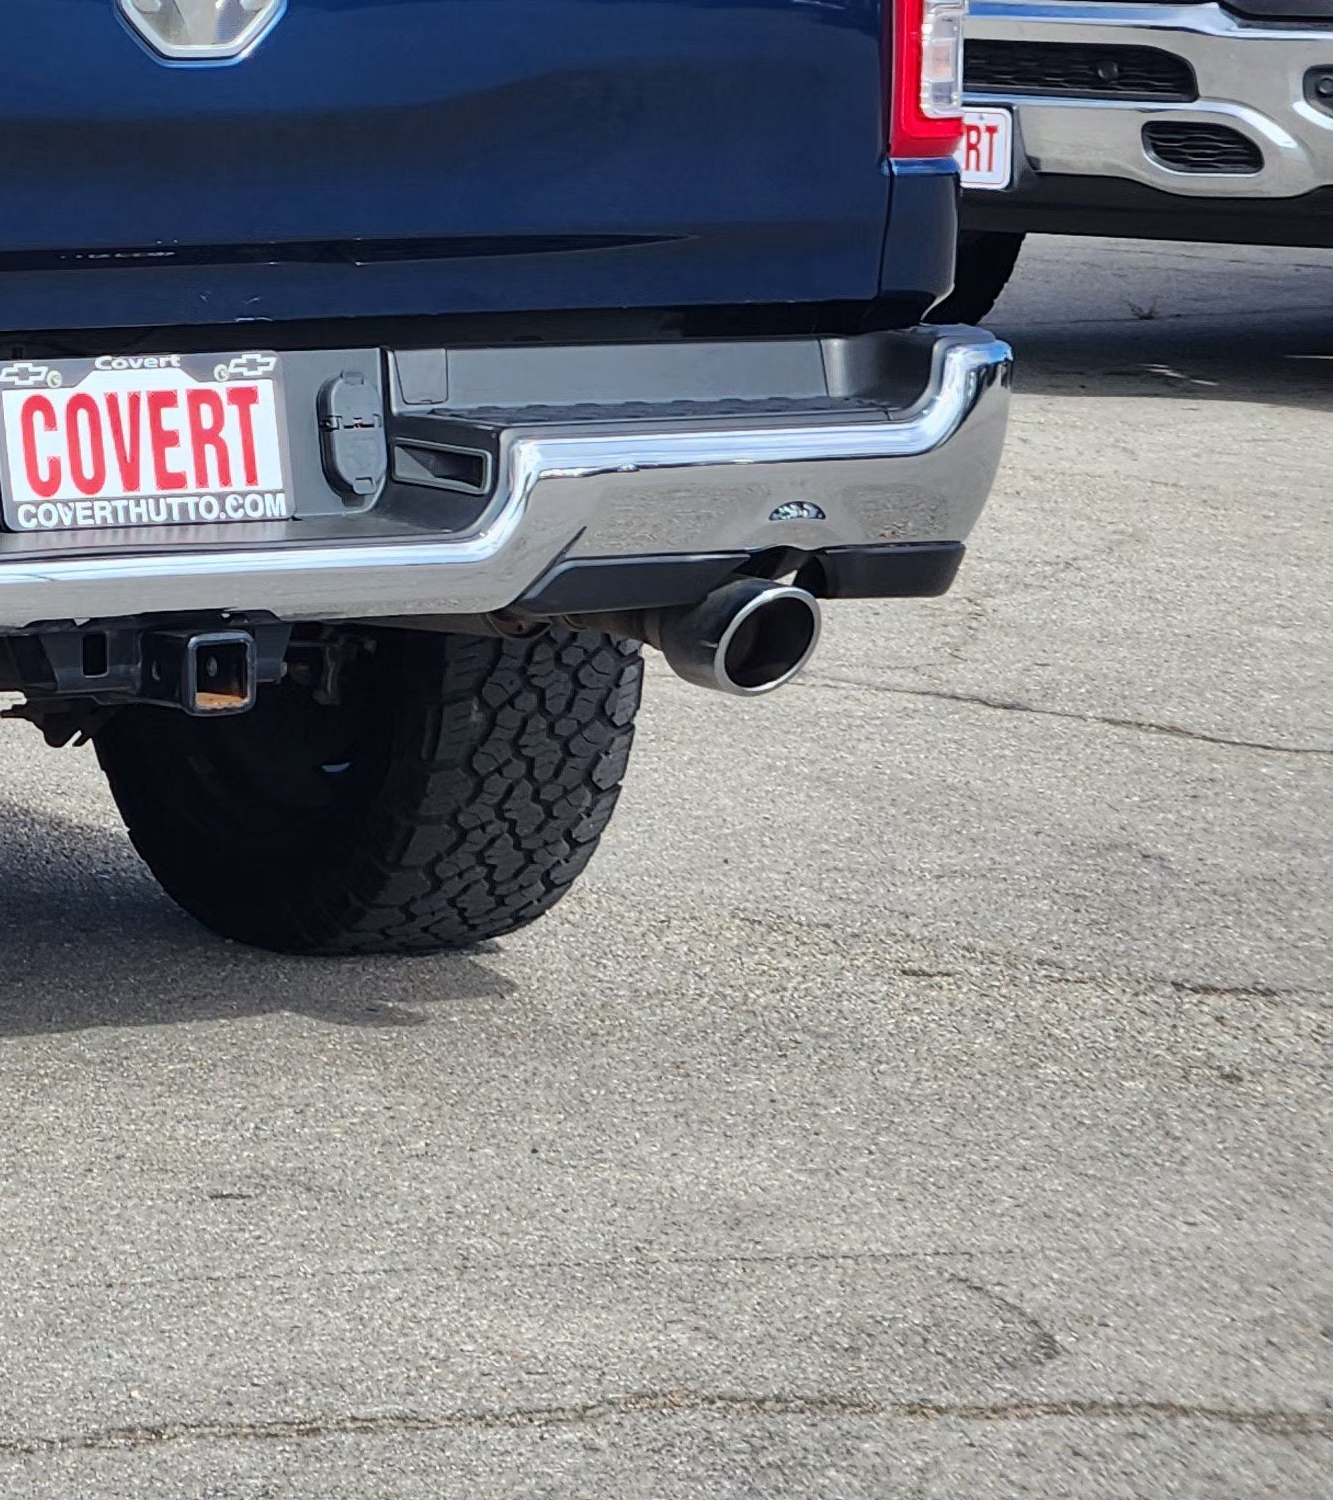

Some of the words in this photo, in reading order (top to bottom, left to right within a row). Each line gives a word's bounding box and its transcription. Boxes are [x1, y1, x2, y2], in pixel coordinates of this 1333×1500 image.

[964, 125, 998, 172] RT
[94, 354, 181, 370] Covert
[20, 386, 260, 498] COVERT
[17, 493, 287, 529] COVERTHUTTO.COM
